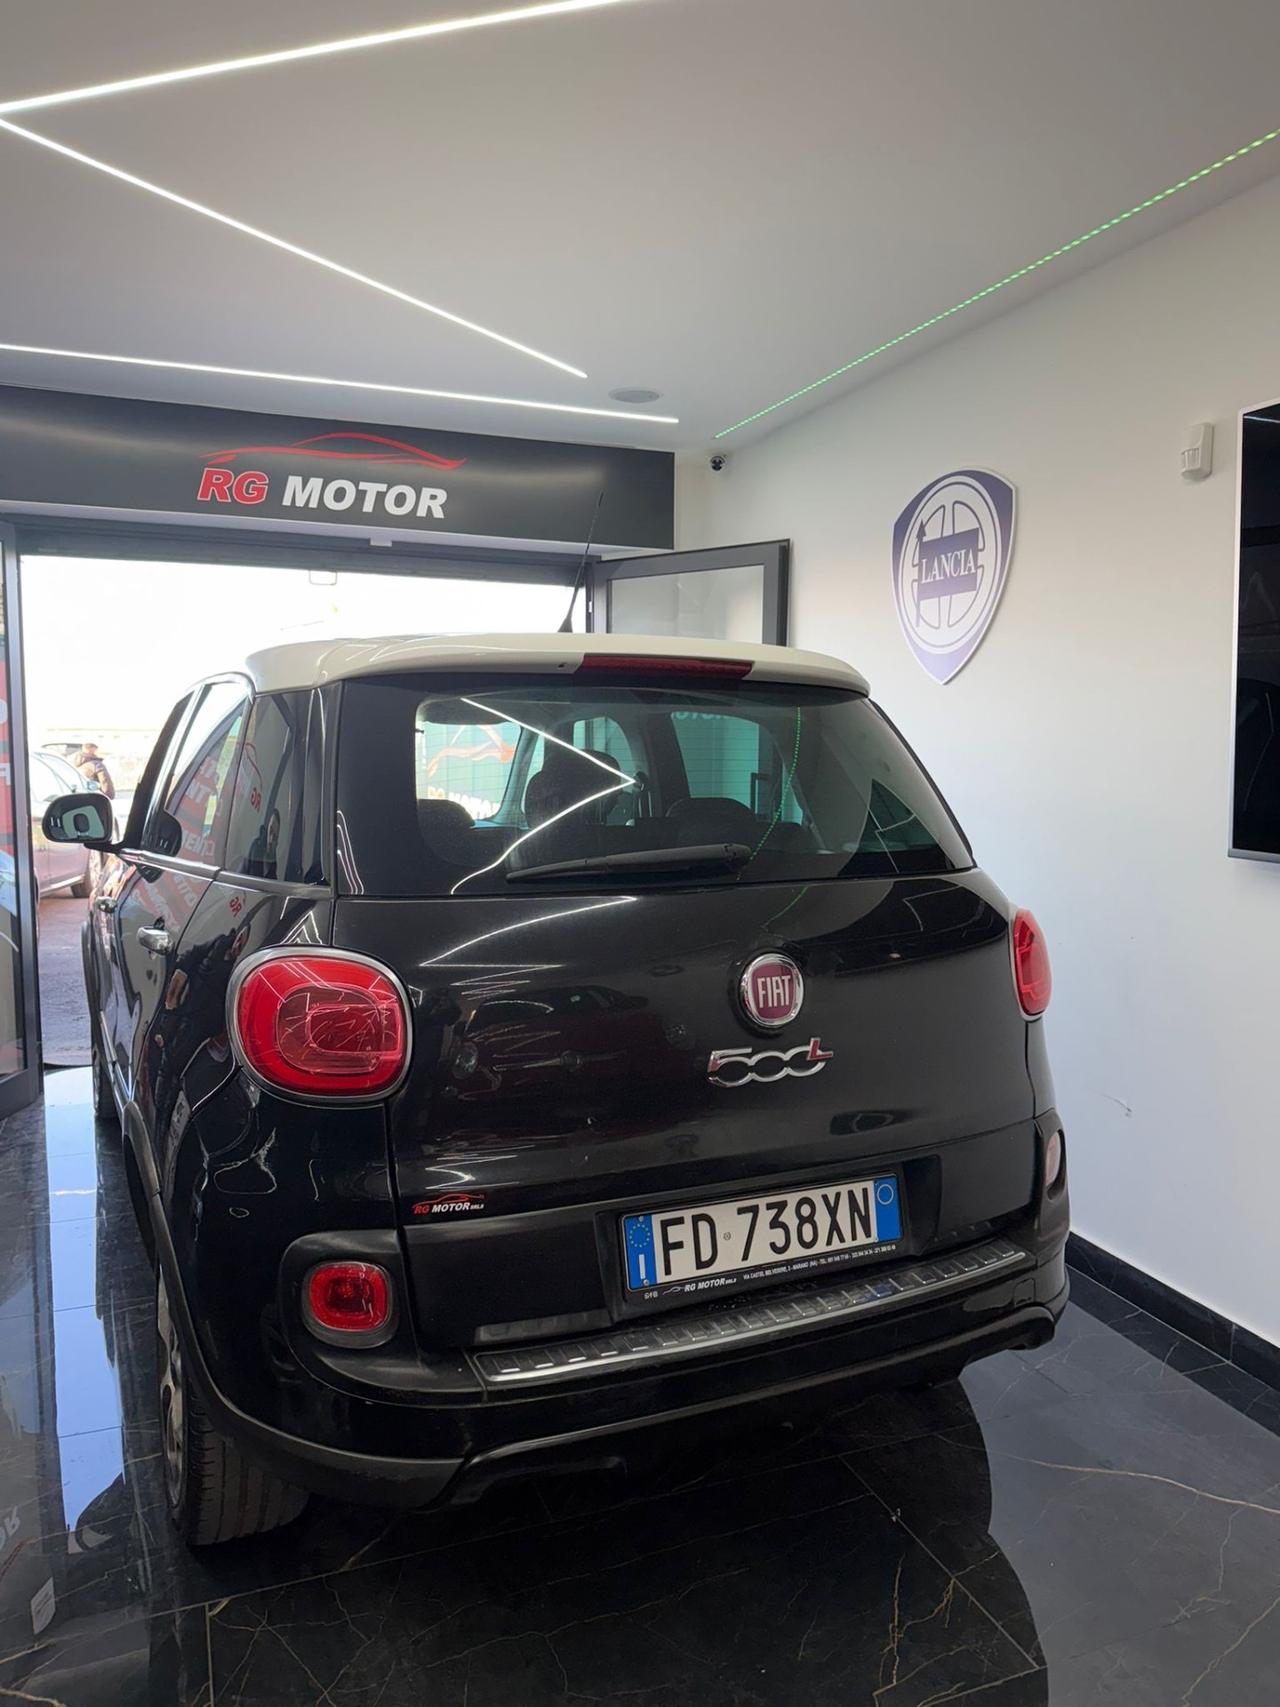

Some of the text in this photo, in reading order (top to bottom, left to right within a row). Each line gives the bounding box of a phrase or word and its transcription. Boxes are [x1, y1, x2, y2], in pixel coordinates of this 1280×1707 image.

[197, 467, 448, 518] RG MOTOR
[921, 548, 977, 585] LANCIA
[757, 975, 791, 1009] FIAT
[707, 1037, 834, 1088] 500L
[414, 1205, 430, 1214] RG
[431, 1202, 470, 1213] MOTOR
[660, 1187, 872, 1276] FD 738XN
[684, 1284, 696, 1293] RG
[697, 1277, 726, 1290] MOTOR
